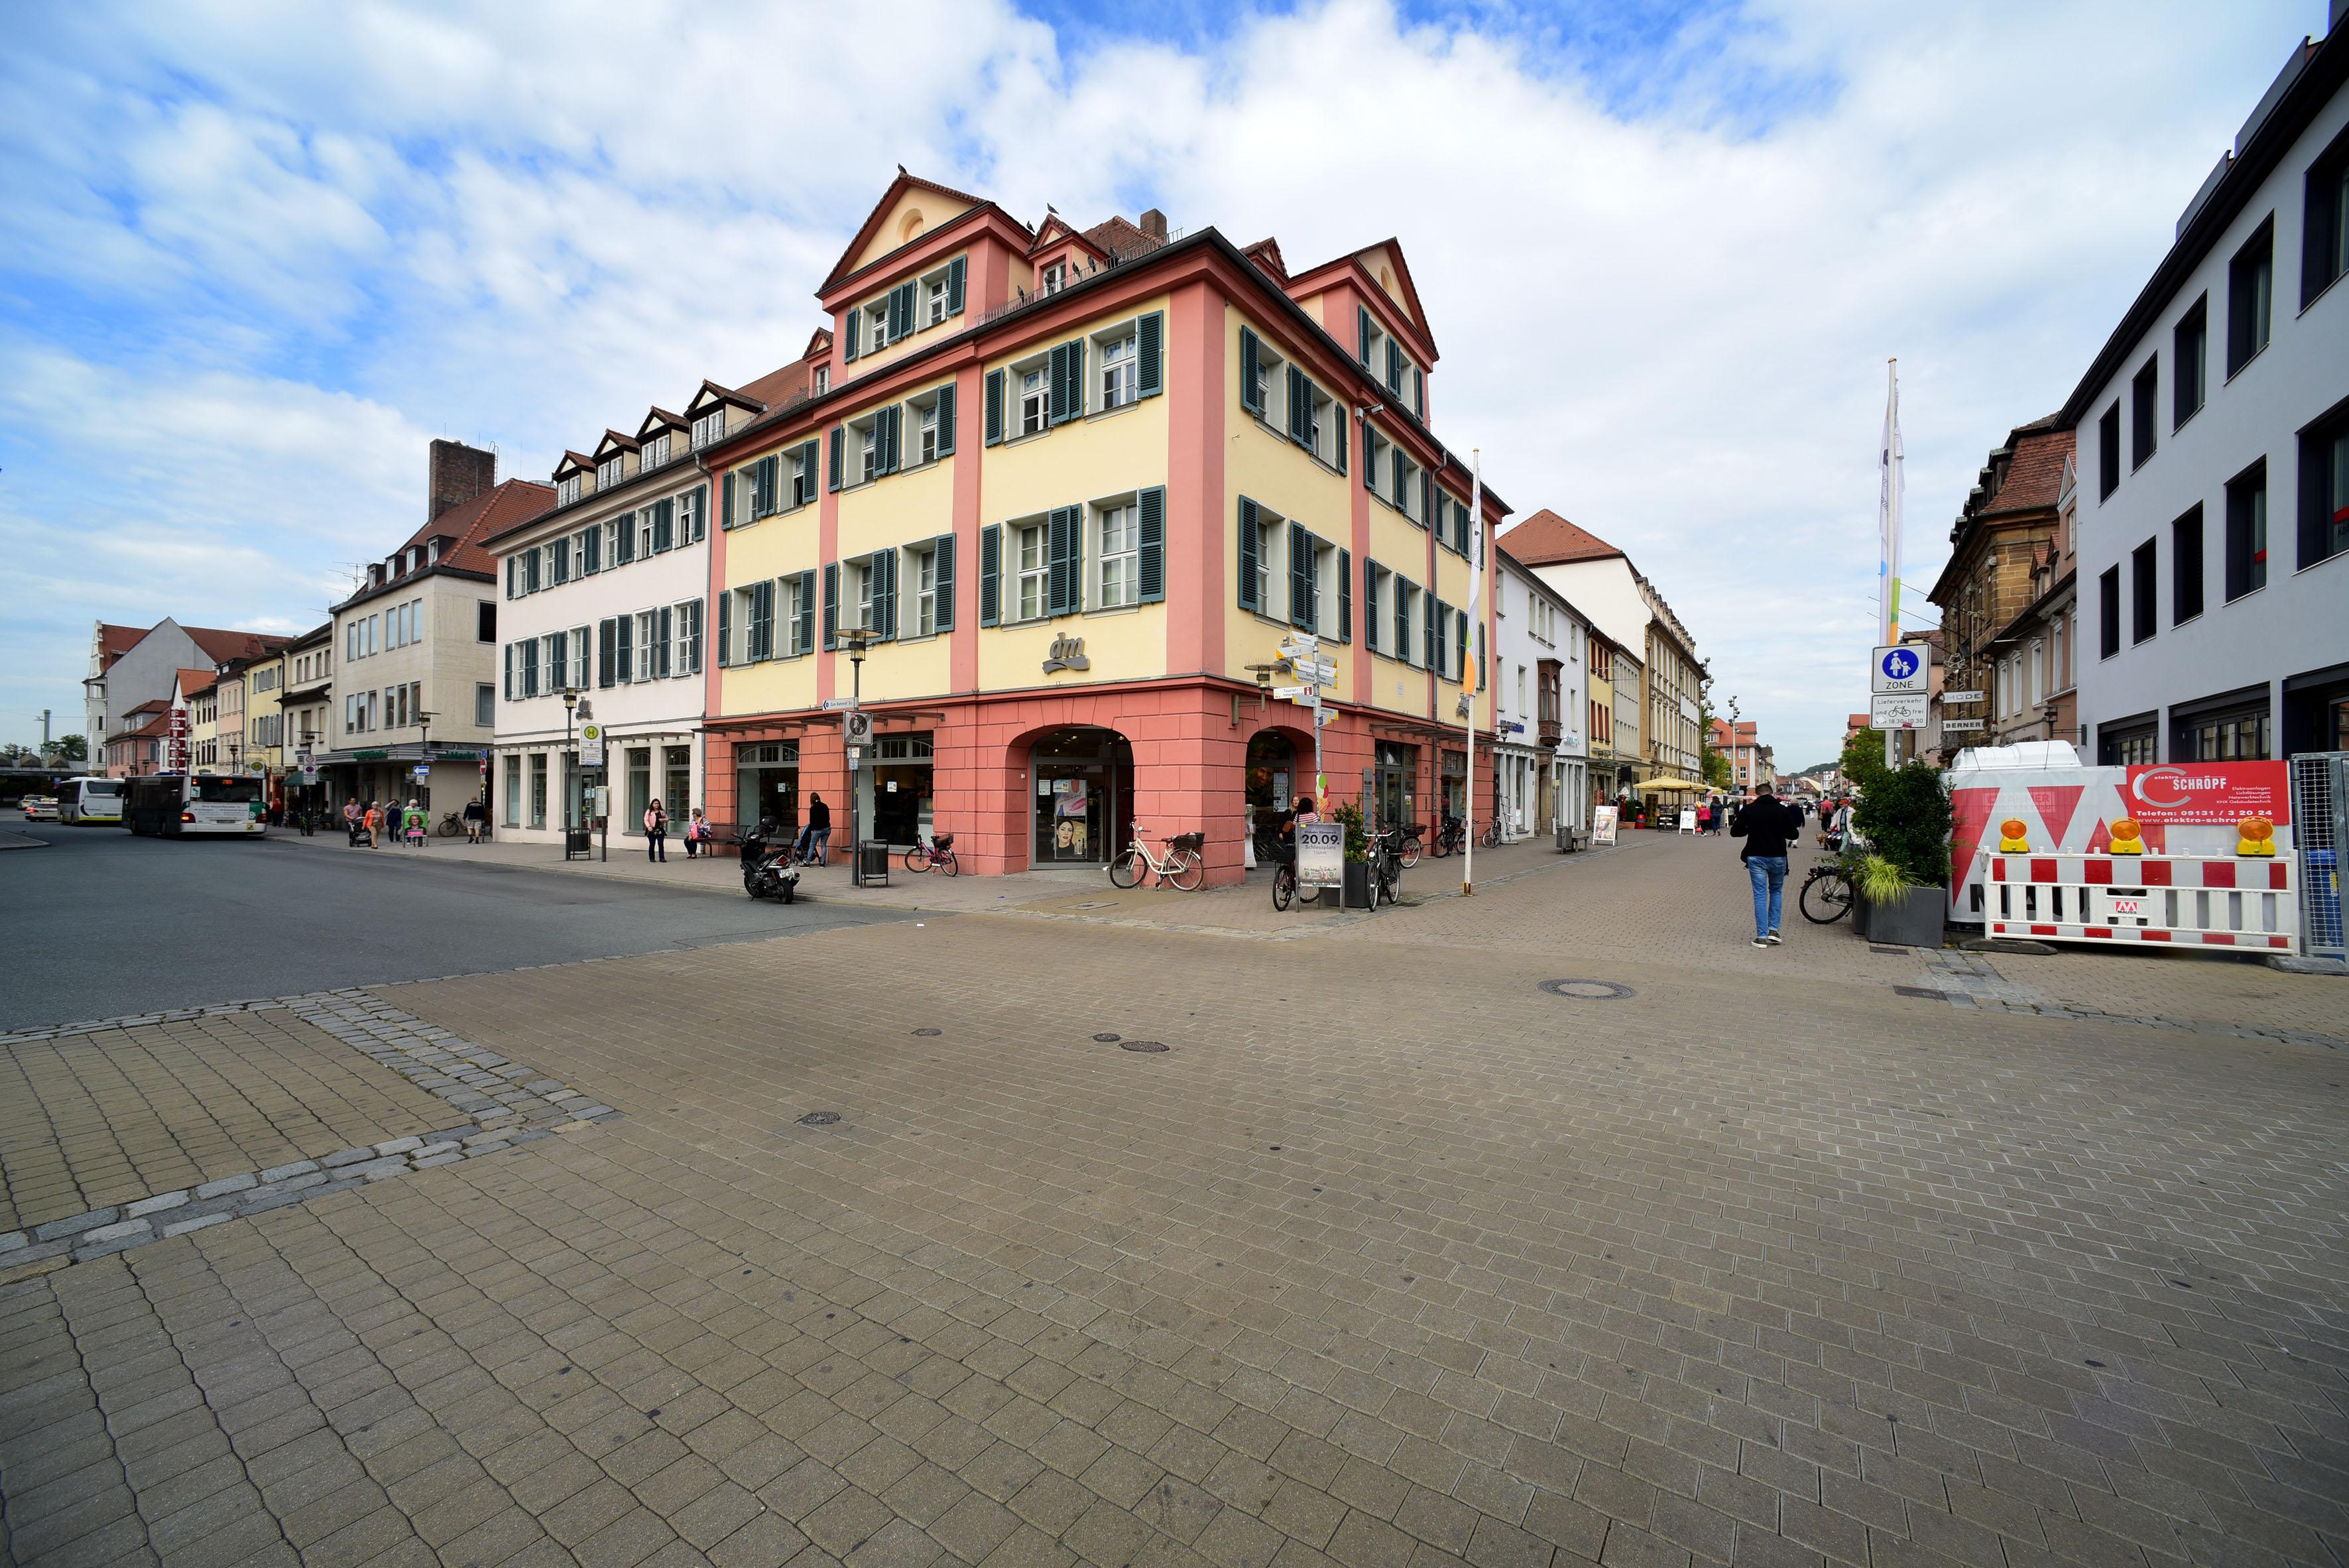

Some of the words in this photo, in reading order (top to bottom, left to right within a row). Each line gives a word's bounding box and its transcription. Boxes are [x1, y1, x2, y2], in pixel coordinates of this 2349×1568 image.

[1050, 632, 1083, 659] dm
[1886, 681, 1913, 690] ZONE
[2173, 775, 2227, 790] SCHRÖPF
[1301, 834, 1340, 845] 20.09.
